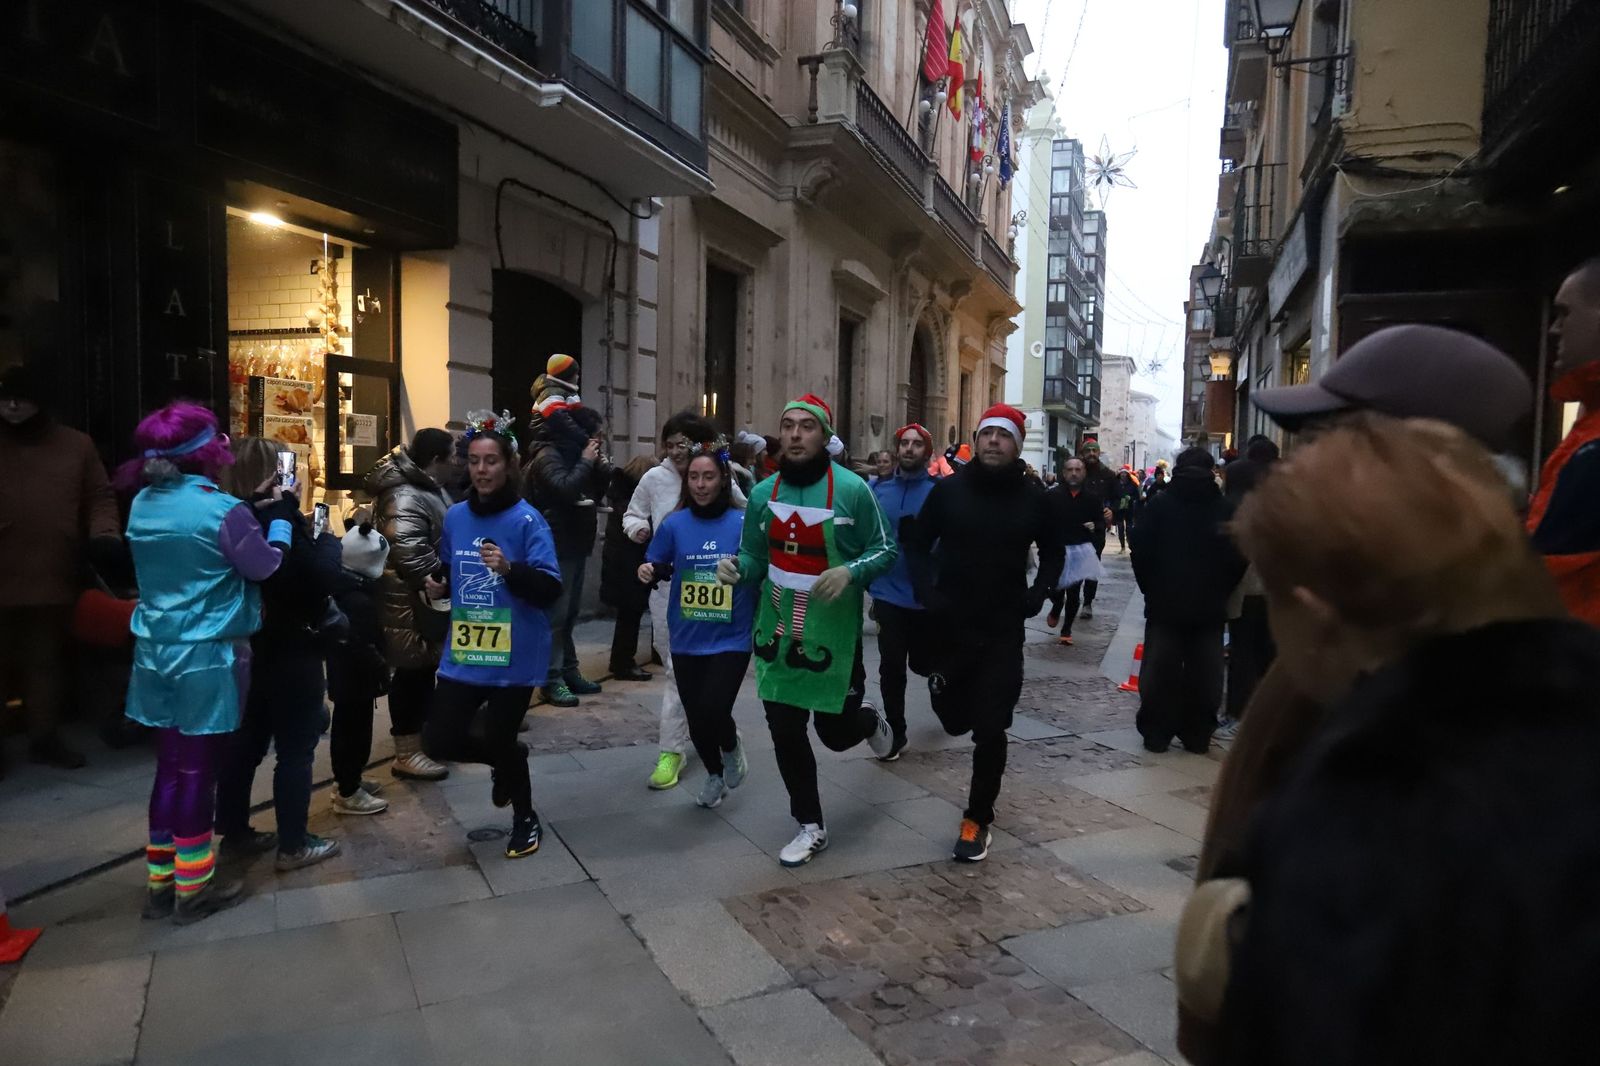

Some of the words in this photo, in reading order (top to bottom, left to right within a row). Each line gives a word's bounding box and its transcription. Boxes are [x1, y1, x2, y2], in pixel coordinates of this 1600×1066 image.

[702, 541, 717, 551] 46
[684, 584, 725, 607] 380
[456, 624, 502, 648] 377
[467, 654, 483, 662] CAJA
